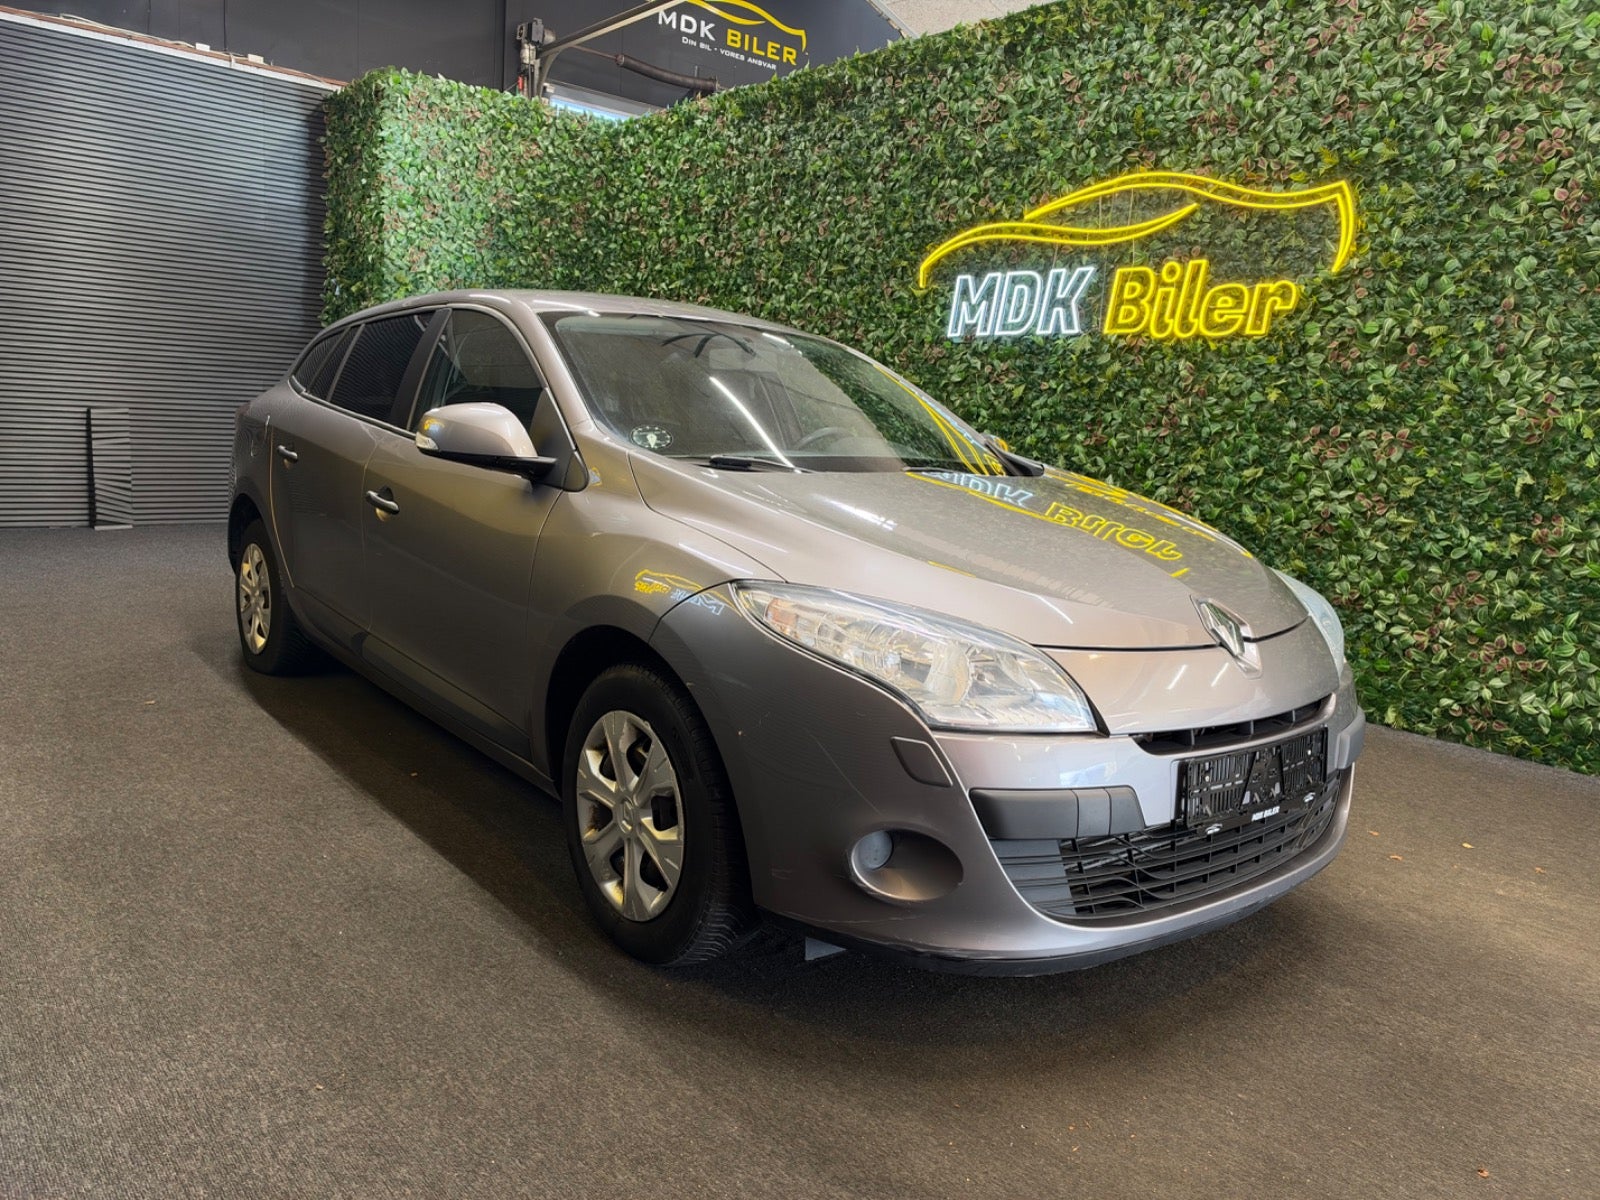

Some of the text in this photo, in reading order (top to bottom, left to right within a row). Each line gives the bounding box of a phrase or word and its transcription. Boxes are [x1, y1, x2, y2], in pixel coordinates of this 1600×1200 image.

[658, 11, 797, 66] MDK BILER
[947, 258, 1299, 339] MDK Biler
